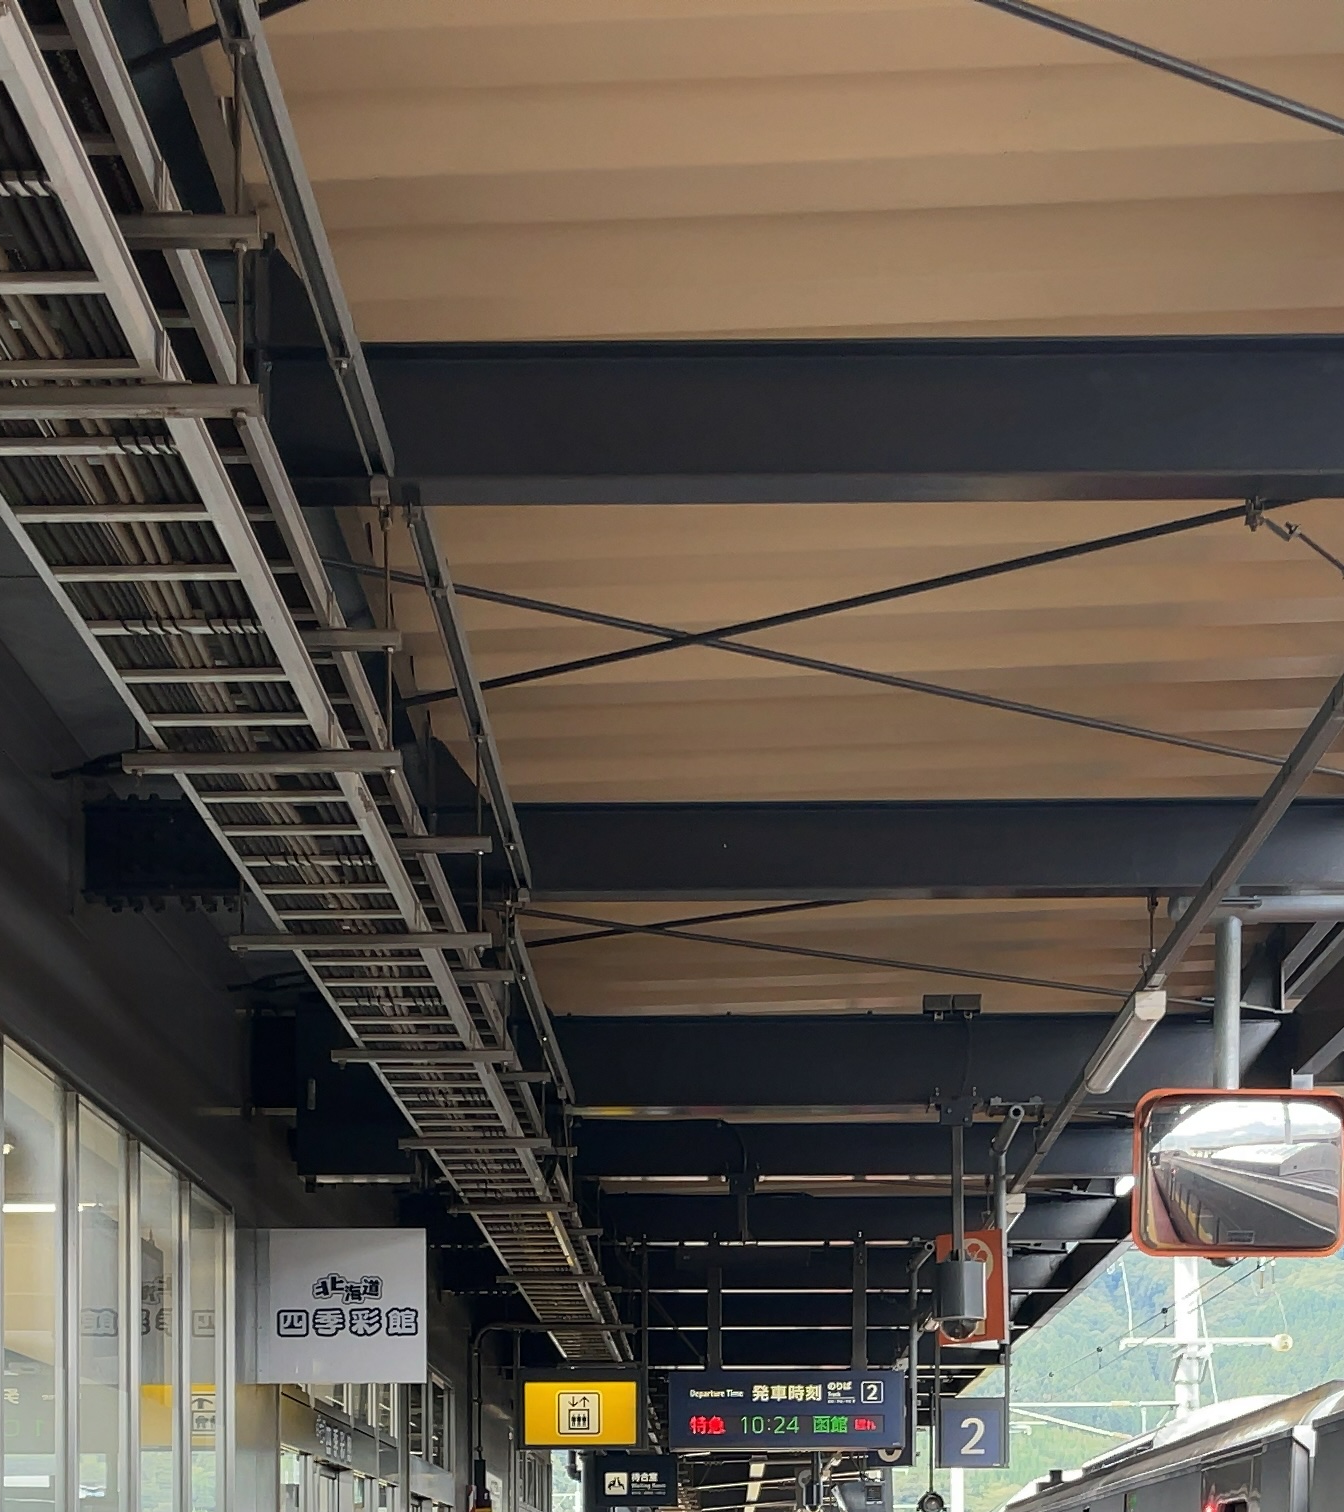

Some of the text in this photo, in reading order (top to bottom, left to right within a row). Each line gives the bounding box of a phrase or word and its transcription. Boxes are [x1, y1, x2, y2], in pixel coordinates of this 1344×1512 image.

[312, 1273, 383, 1304] 北海道
[277, 1307, 419, 1338] 四季彩館
[690, 1388, 744, 1399] Departure Time
[752, 1384, 822, 1402] 発車時刻
[827, 1381, 853, 1391] のりば
[866, 1384, 879, 1401] 2
[689, 1415, 726, 1435] 特急
[741, 1415, 800, 1435] 10:24
[813, 1415, 849, 1434] 函館
[960, 1416, 986, 1455] 2
